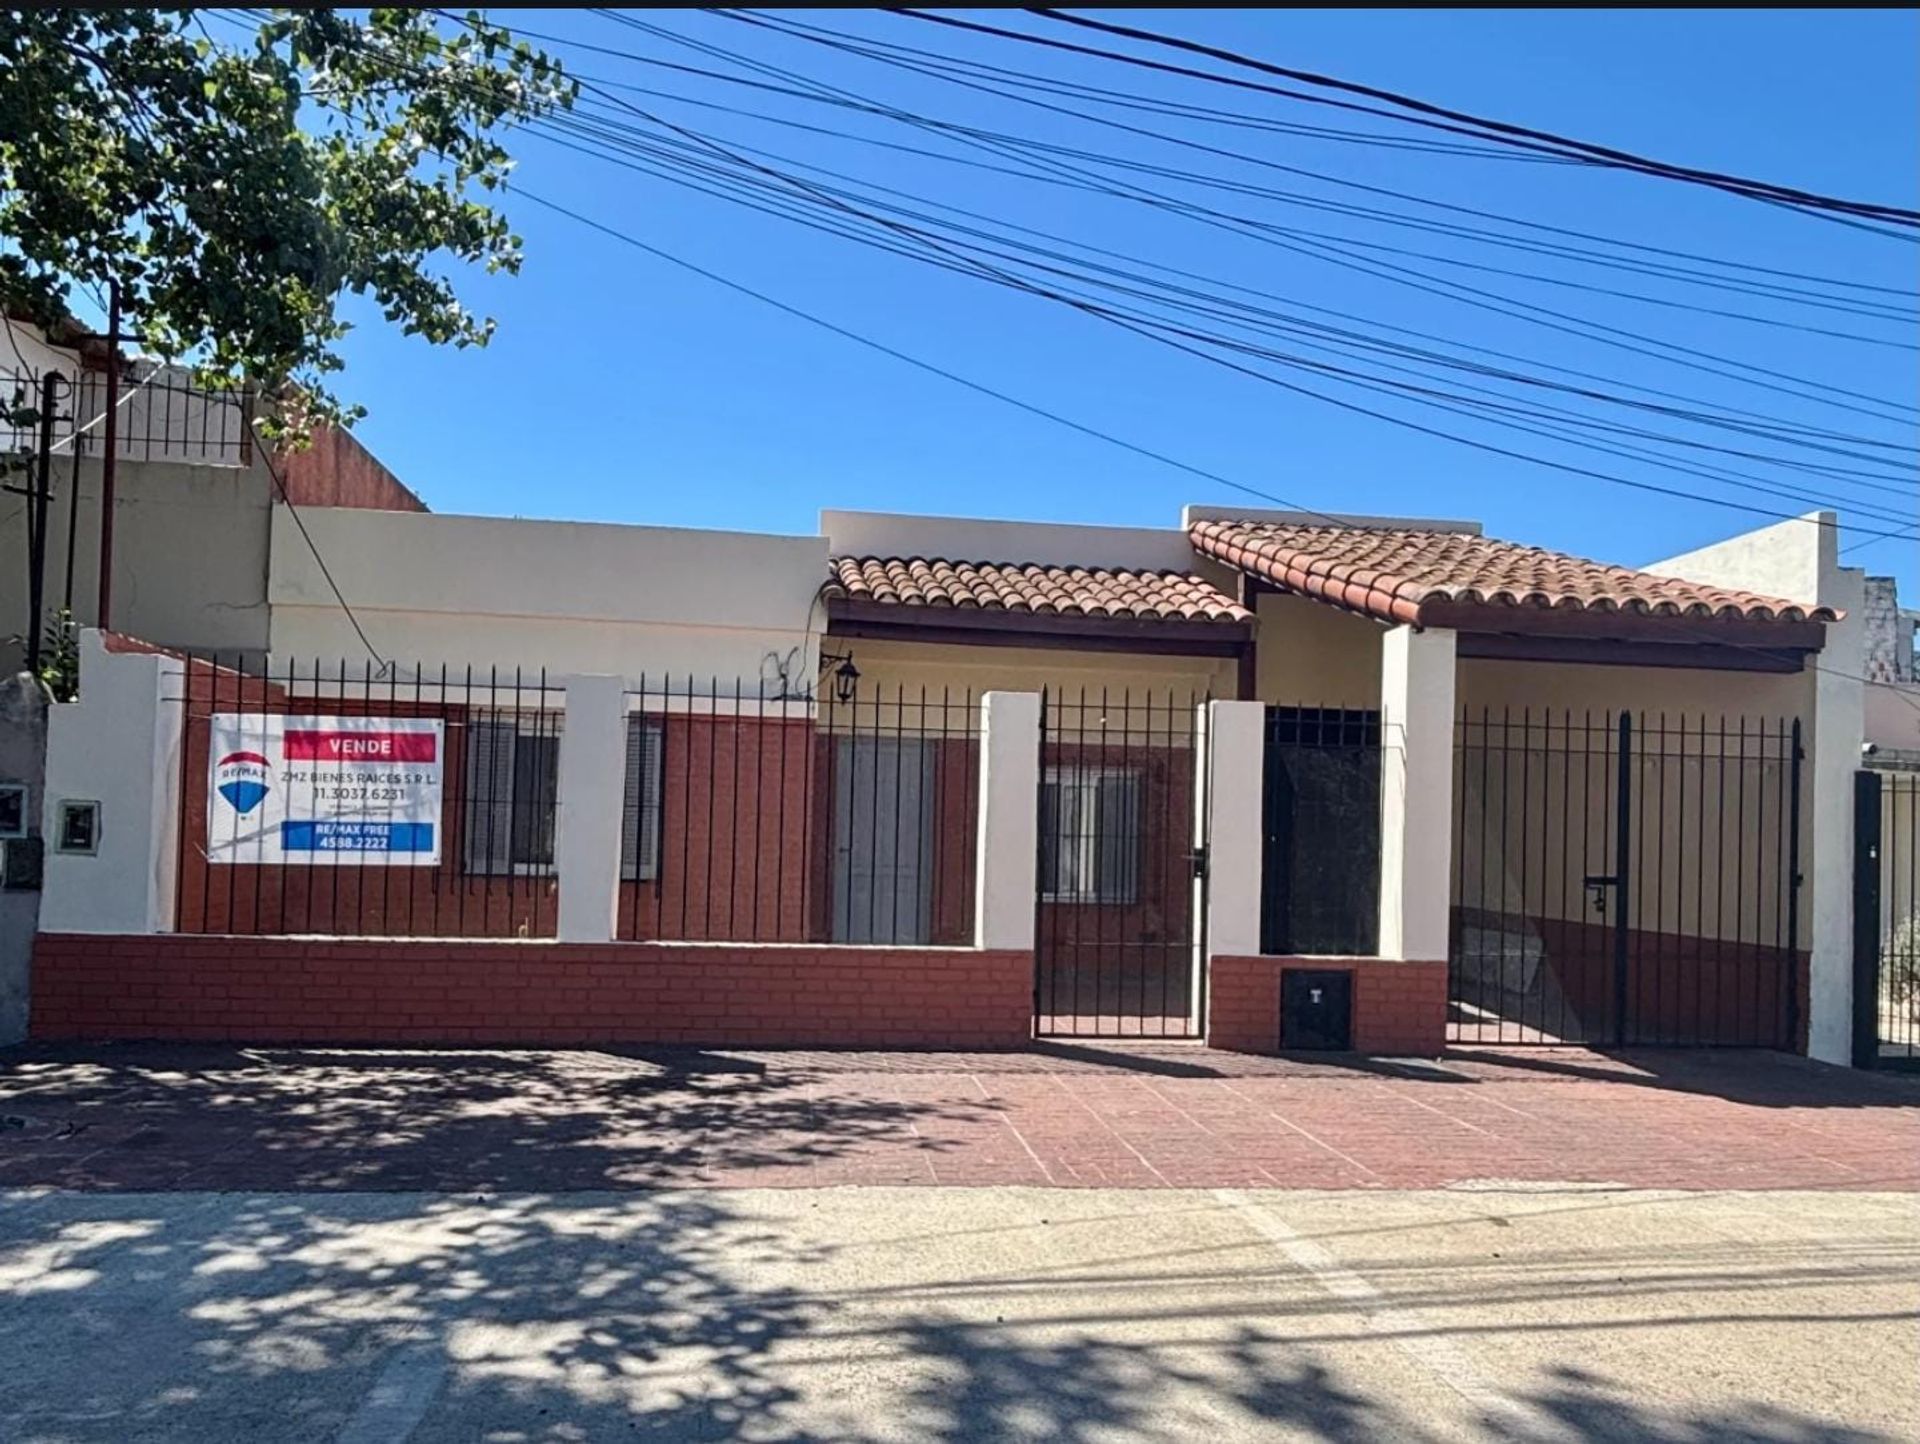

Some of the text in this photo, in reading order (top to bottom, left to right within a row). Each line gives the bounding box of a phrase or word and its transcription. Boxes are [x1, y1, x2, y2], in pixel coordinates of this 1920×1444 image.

[329, 738, 391, 754] VENDE
[310, 772, 353, 784] BIENES
[313, 787, 405, 800] 11.3037.6231
